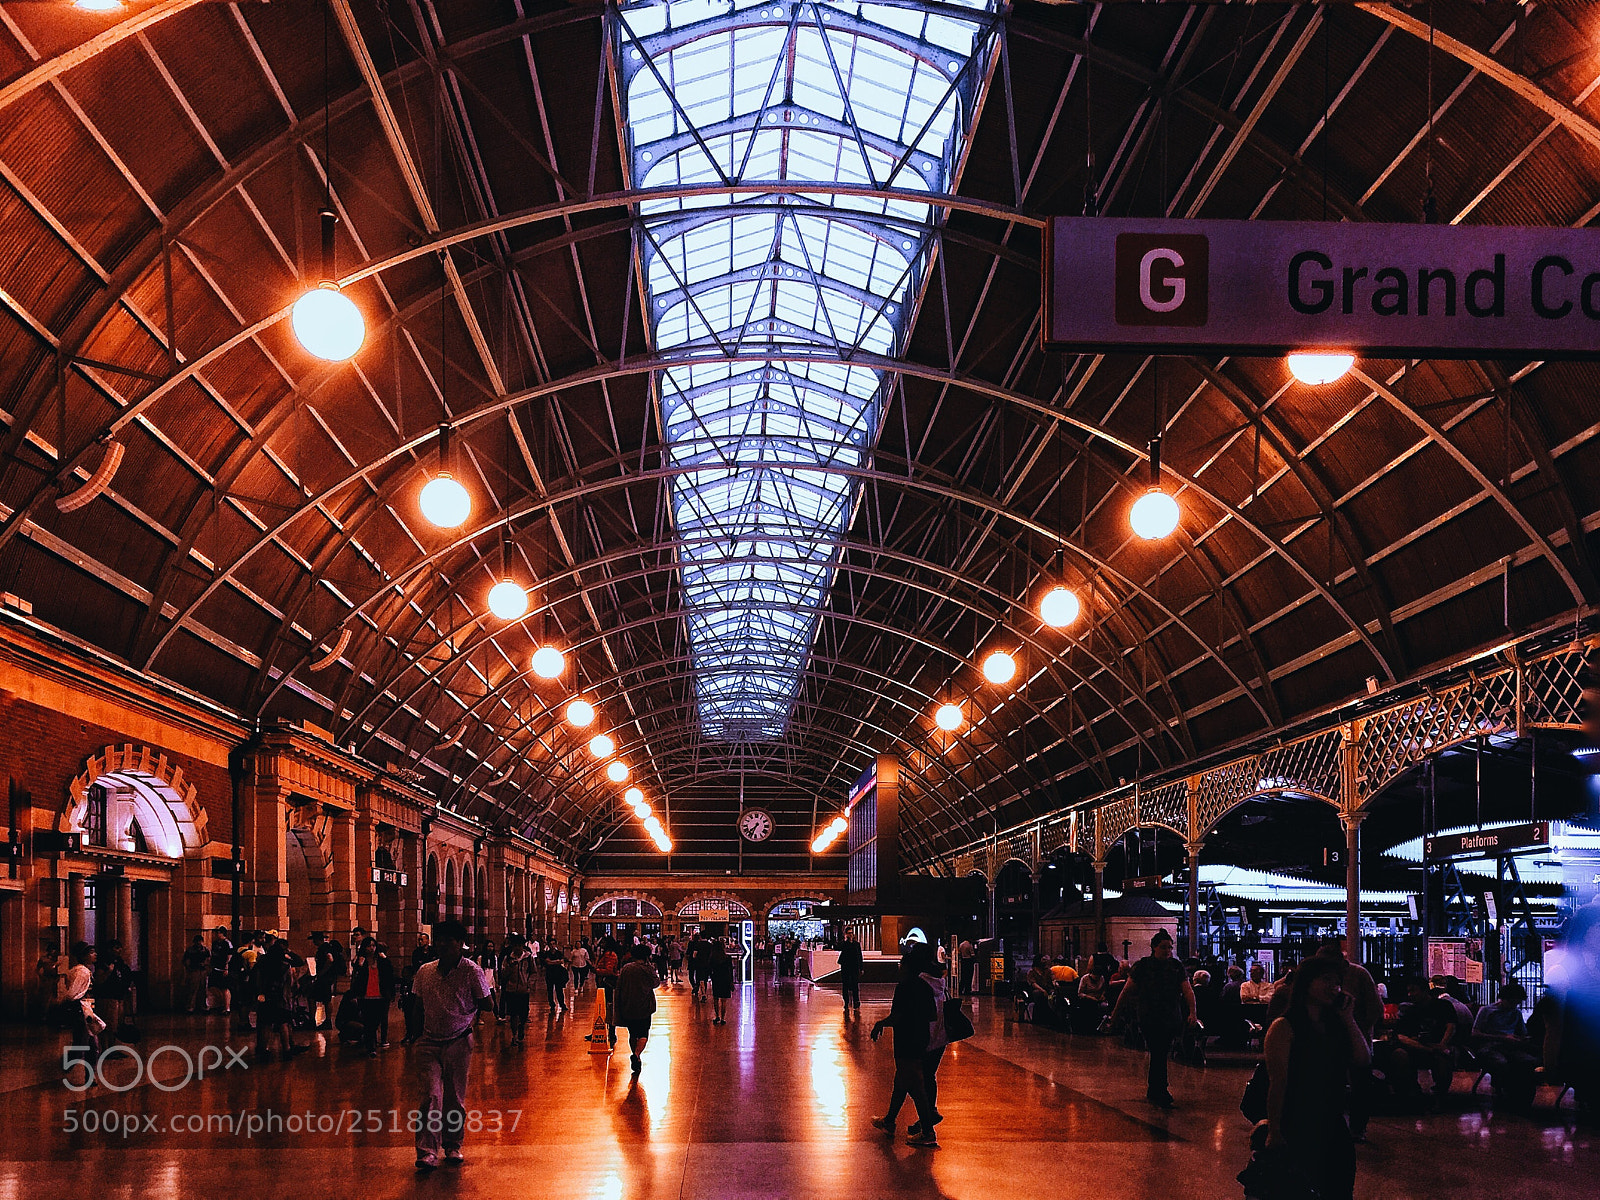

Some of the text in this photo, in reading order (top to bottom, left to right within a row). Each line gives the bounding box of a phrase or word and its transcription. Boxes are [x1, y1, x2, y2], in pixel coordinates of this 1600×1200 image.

[1139, 247, 1187, 313] G
[1288, 250, 1505, 318] Grand
[1426, 827, 1540, 853] 3 Platforms 2
[1331, 851, 1339, 861] 3
